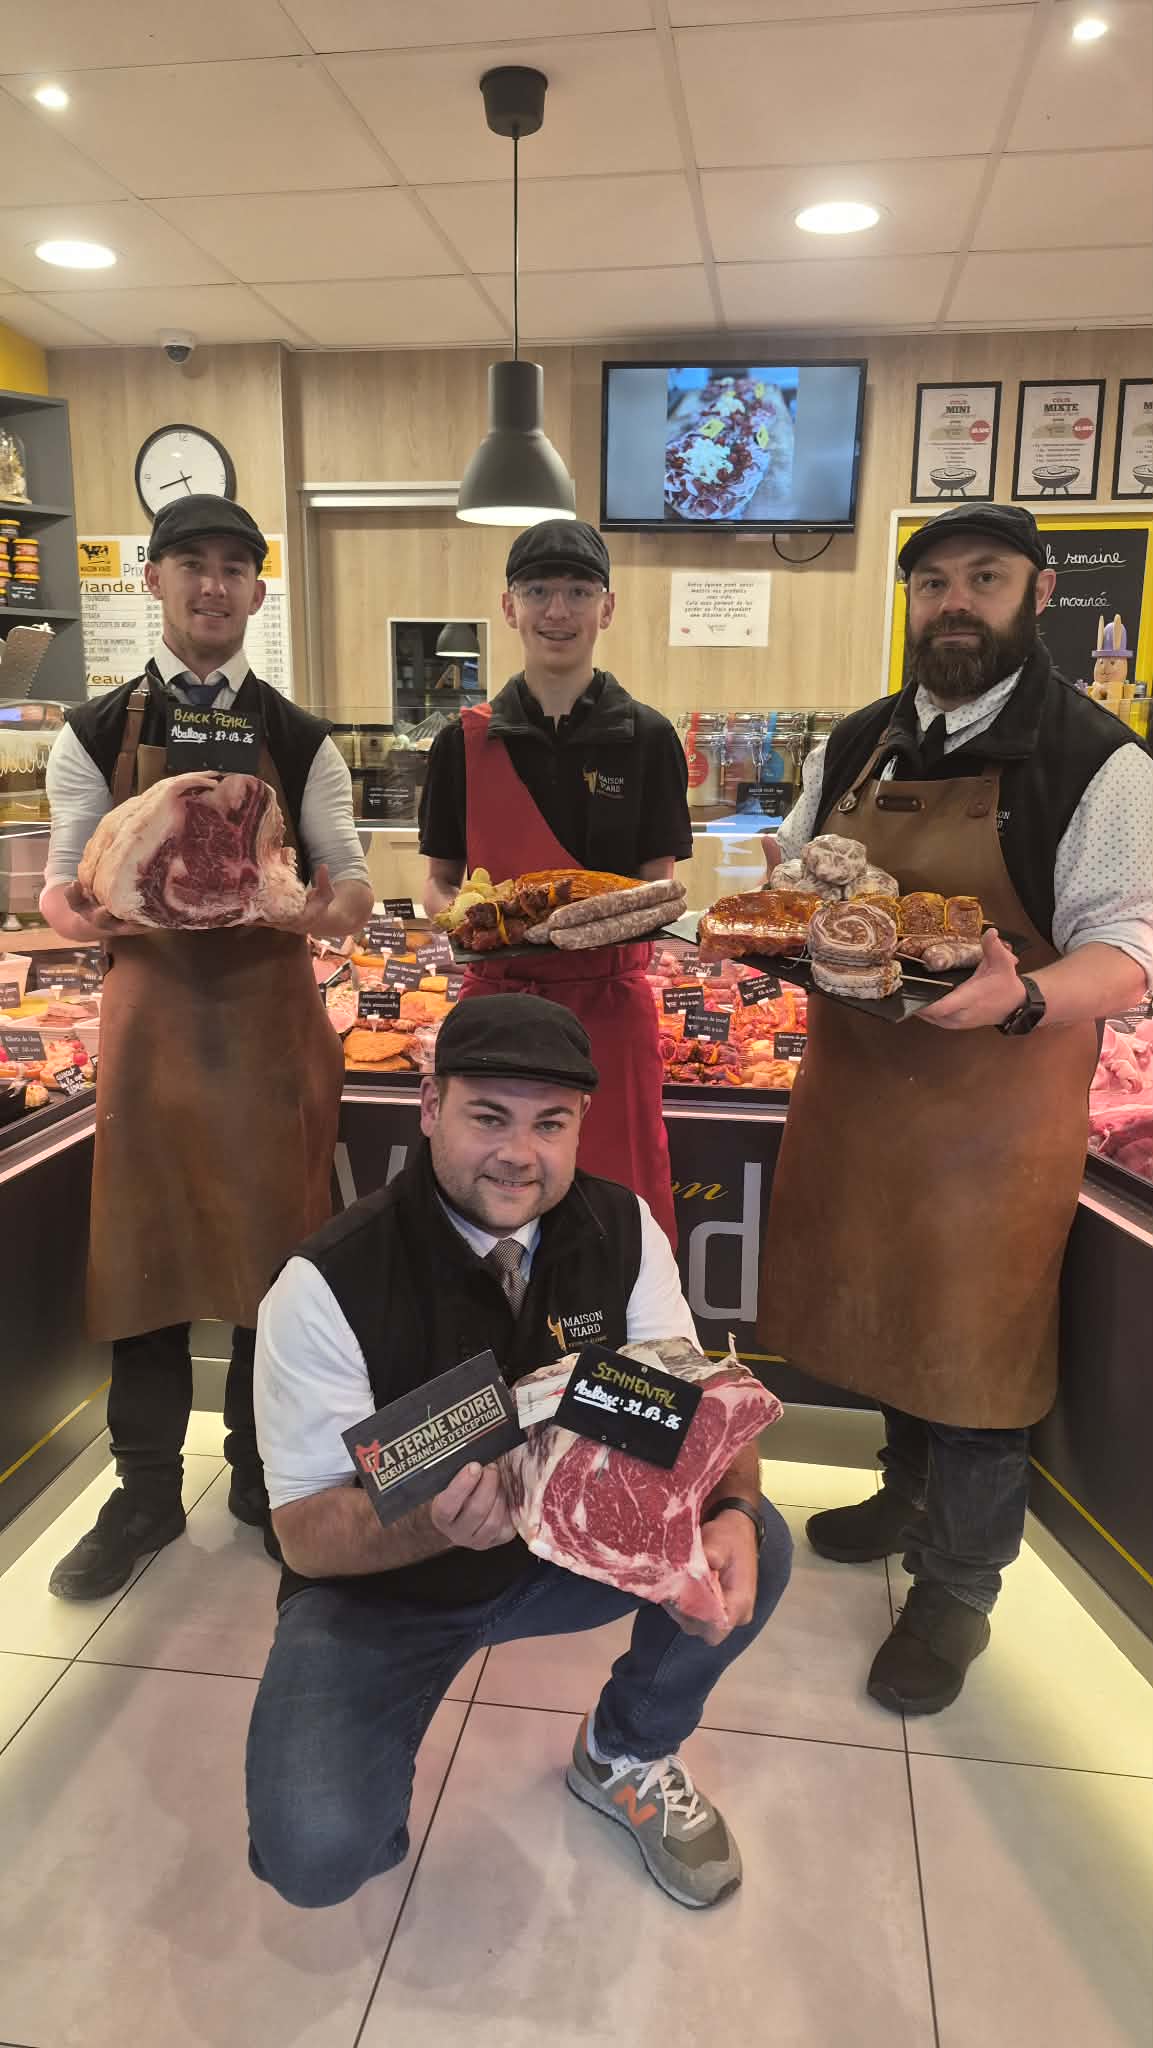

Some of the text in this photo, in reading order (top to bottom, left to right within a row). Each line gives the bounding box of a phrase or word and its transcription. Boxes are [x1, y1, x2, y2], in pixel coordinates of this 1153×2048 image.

[945, 405, 971, 414] MINI
[1044, 403, 1080, 412] MIXTE
[1045, 543, 1127, 565] la semaine
[123, 563, 144, 577] Prix
[174, 708, 253, 729] BLACK PEARL
[562, 1311, 603, 1328] MAISON
[570, 1323, 601, 1338] VIARD
[375, 1390, 497, 1474] LA FERME NOIRE
